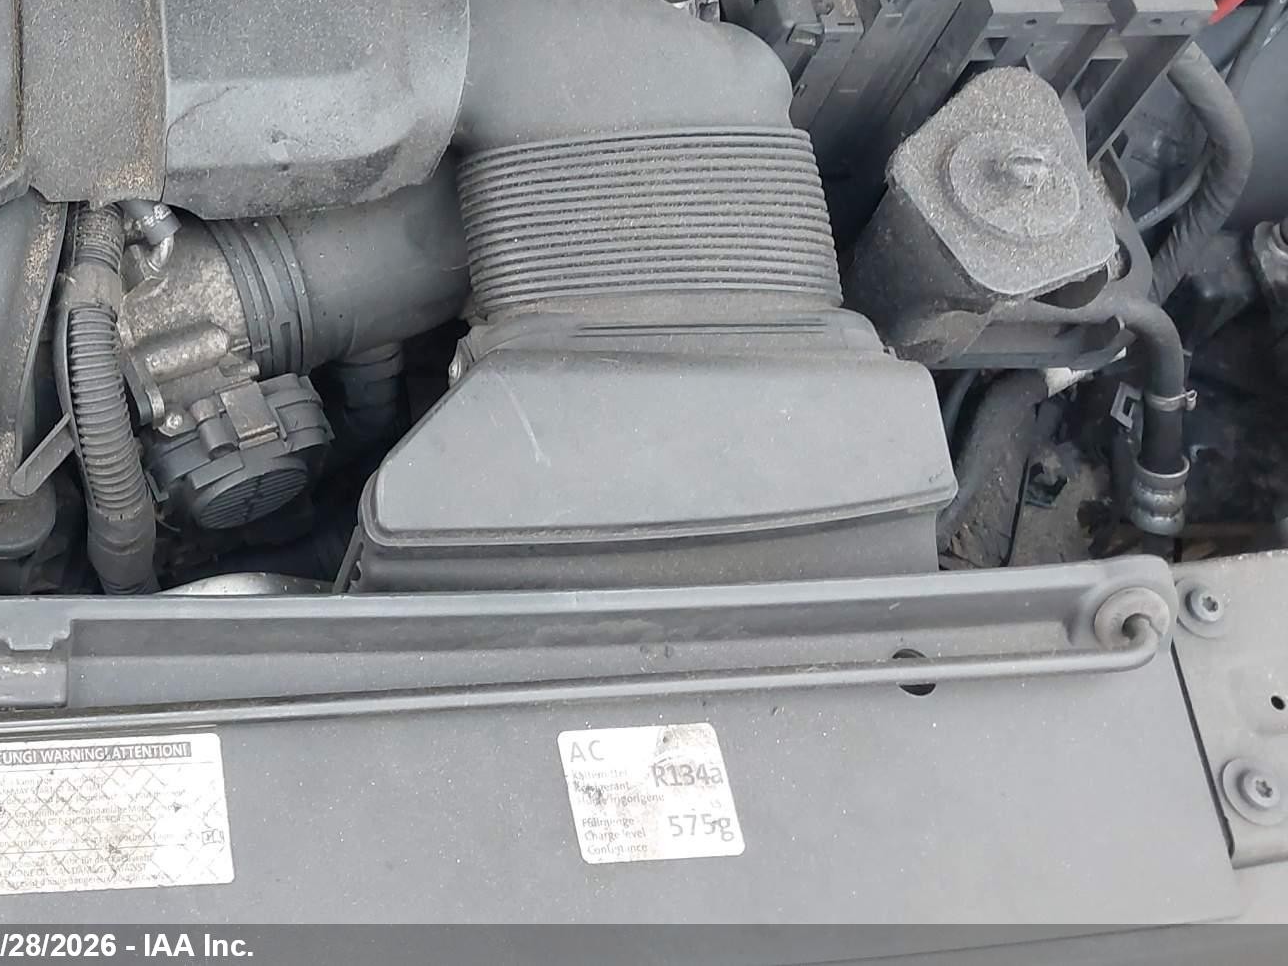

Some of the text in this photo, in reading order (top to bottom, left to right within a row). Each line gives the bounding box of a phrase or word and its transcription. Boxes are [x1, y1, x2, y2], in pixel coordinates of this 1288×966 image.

[39, 747, 111, 764] WARNING!
[112, 742, 189, 759] ATTENTION!
[652, 762, 725, 788] R134a
